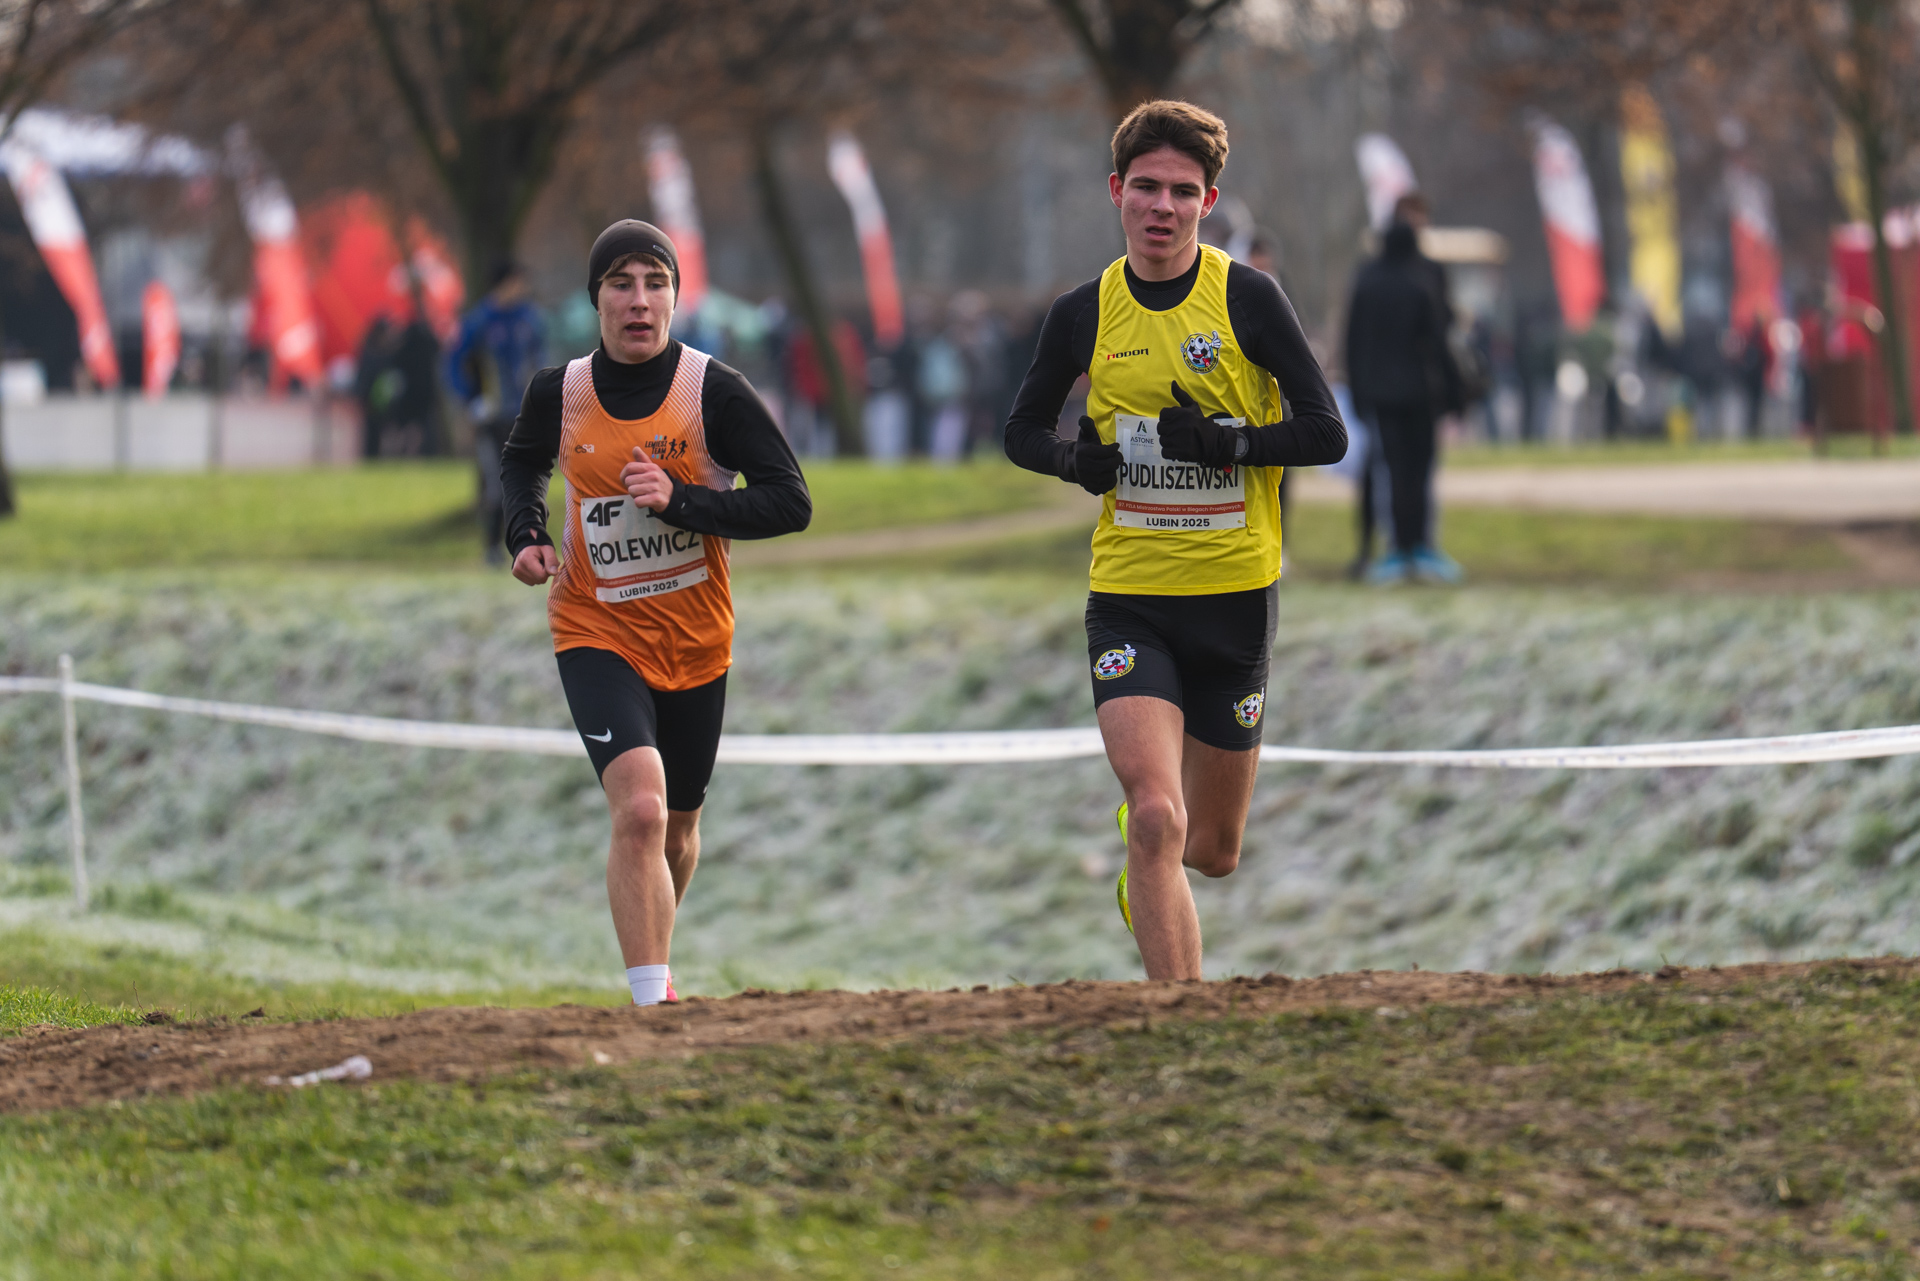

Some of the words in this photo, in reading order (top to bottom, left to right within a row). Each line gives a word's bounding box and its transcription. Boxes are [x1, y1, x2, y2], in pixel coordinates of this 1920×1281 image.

[1130, 436, 1155, 445] ASTONE
[574, 444, 595, 454] esa
[651, 447, 667, 455] TEAM
[1120, 461, 1239, 490] PUDLISZEWSKI
[586, 499, 625, 527] 4F
[1137, 504, 1166, 512] Mistrzostwa
[1146, 517, 1179, 527] LUBIN
[1182, 518, 1210, 527] 2025
[589, 530, 700, 566] ROLEWICZ
[619, 586, 651, 599] LUBIN
[652, 579, 679, 592] 2025
